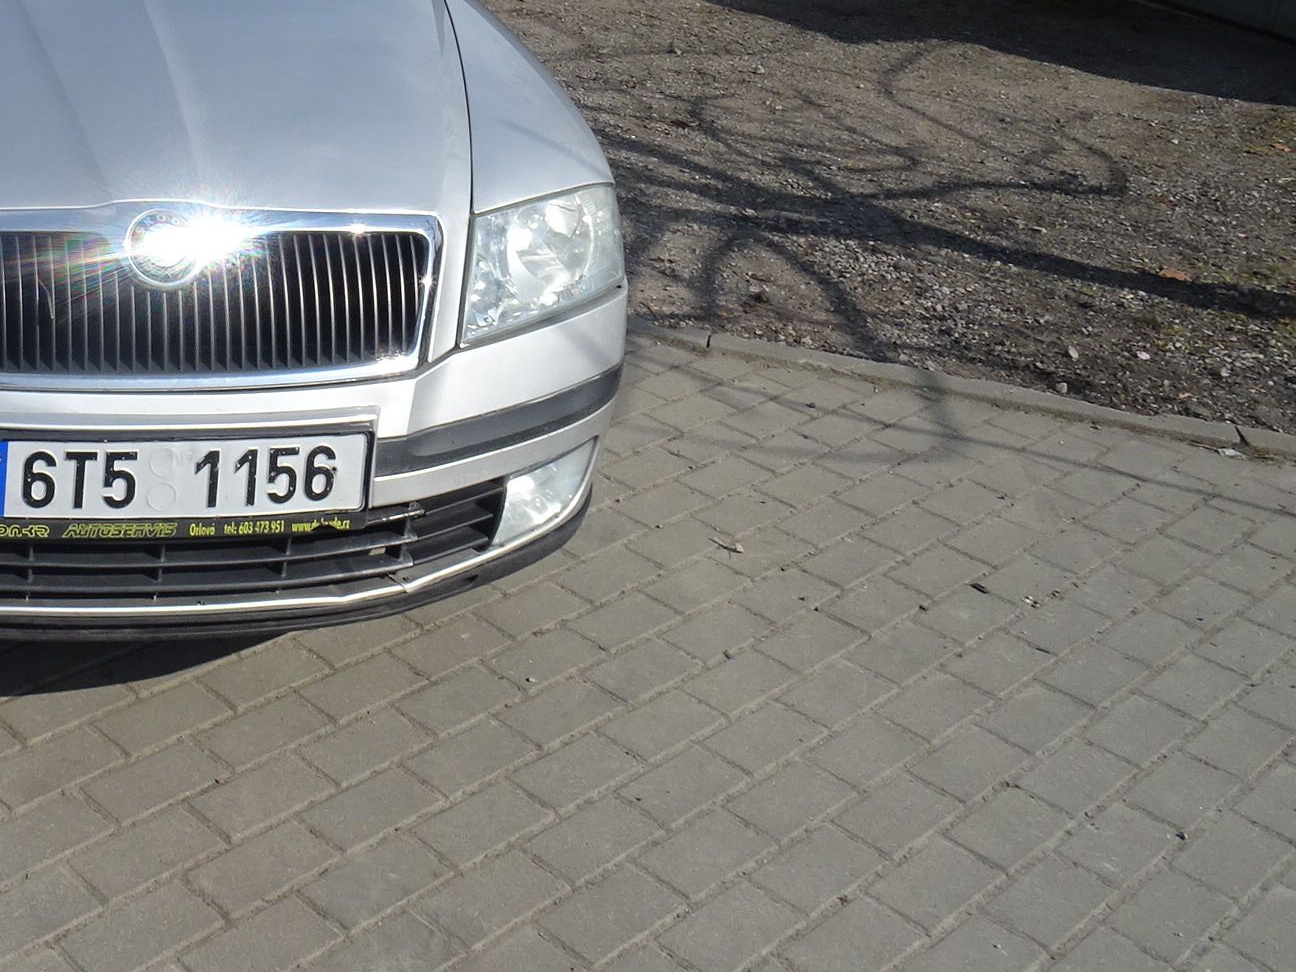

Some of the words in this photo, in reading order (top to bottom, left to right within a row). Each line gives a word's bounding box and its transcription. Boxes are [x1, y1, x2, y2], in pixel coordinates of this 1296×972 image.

[21, 450, 138, 509] 6T5
[194, 444, 337, 508] 1156
[224, 520, 237, 535] tel:
